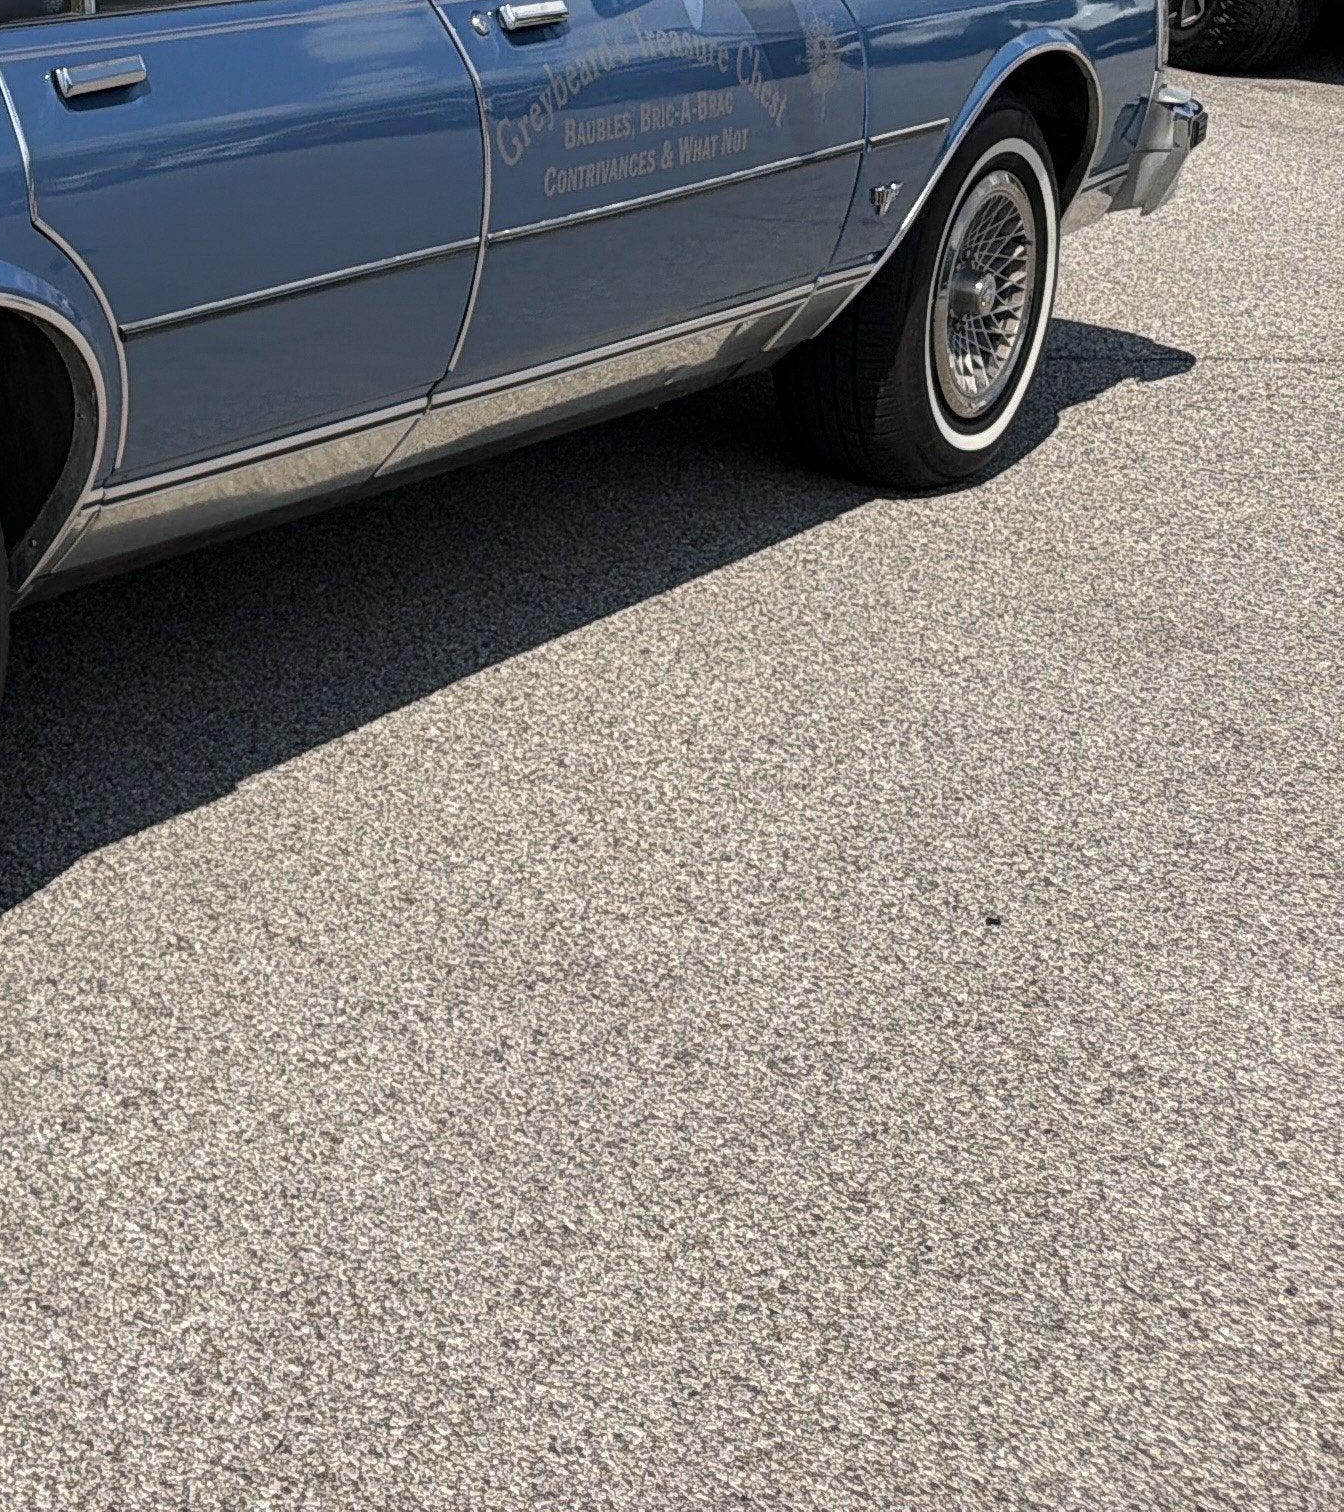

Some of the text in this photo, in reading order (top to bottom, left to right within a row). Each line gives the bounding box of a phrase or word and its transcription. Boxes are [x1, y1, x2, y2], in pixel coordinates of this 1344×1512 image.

[736, 40, 790, 129] Chest
[543, 126, 749, 198] CONTRIVANCES & WHAT NOT
